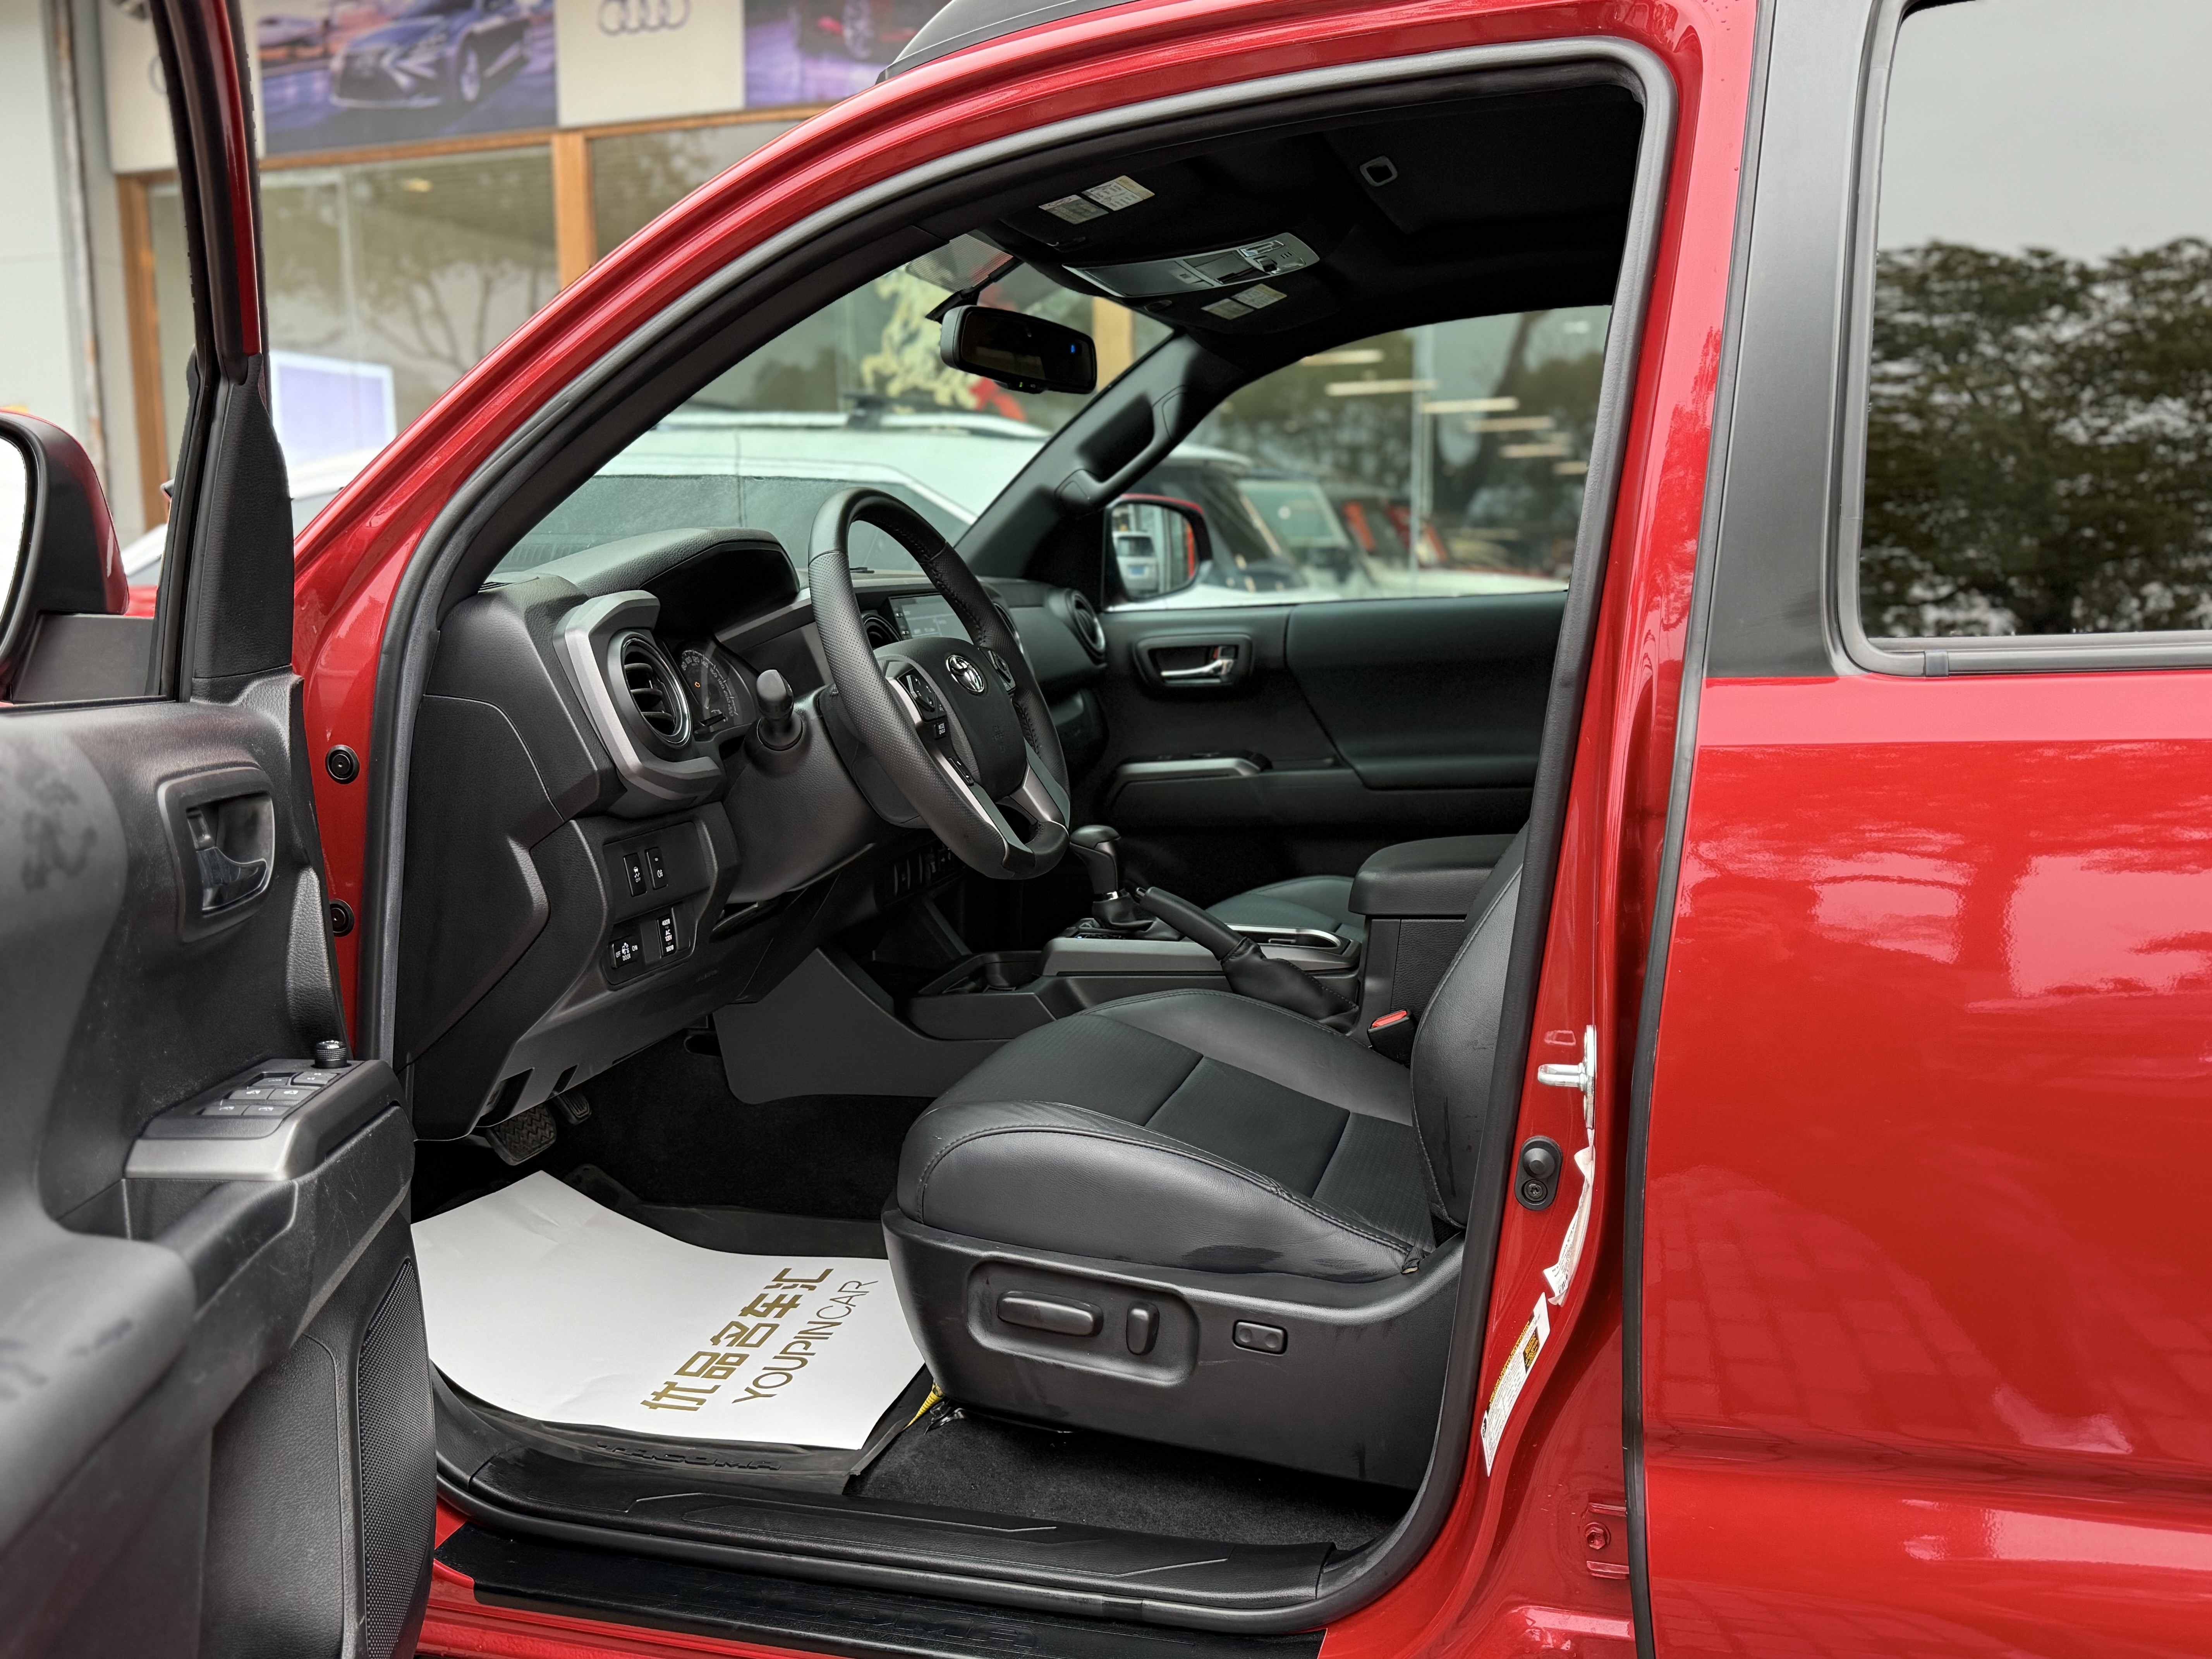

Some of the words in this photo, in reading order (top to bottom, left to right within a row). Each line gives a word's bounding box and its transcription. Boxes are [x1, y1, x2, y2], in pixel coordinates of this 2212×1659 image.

[622, 953, 631, 961] DOOR
[640, 1267, 834, 1412] 优品名车汇
[596, 1441, 782, 1471] TACOMA
